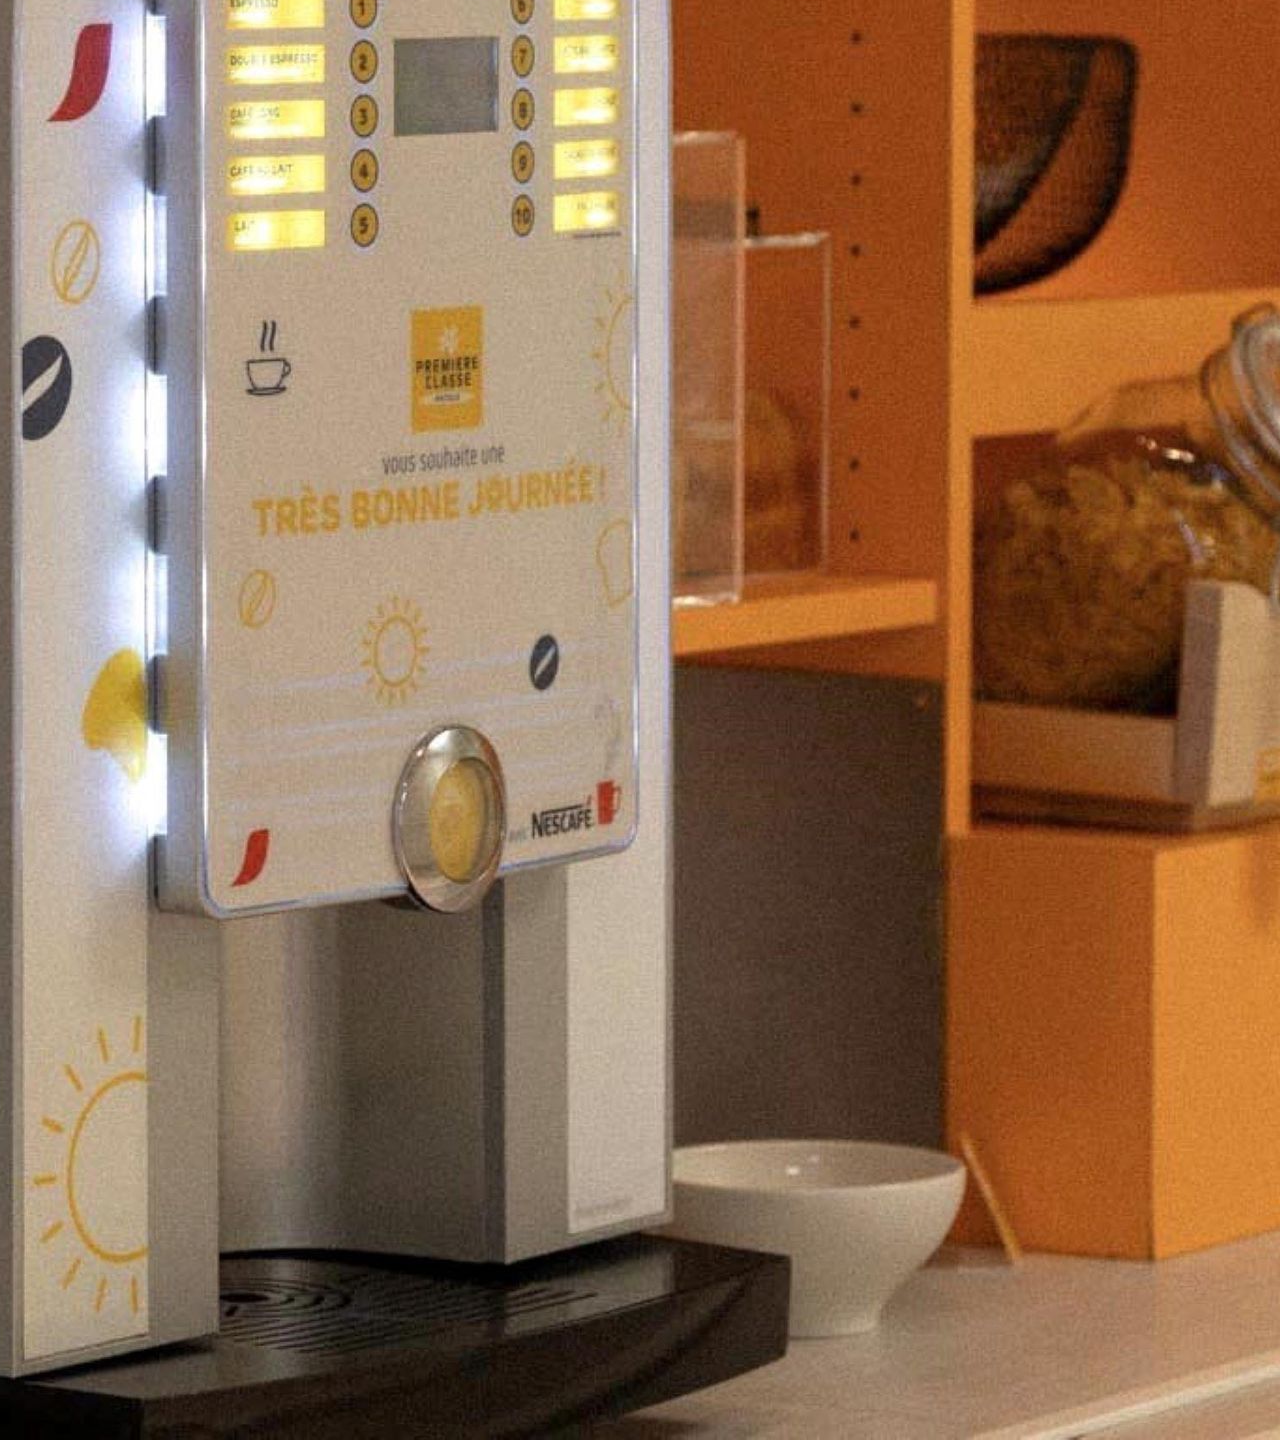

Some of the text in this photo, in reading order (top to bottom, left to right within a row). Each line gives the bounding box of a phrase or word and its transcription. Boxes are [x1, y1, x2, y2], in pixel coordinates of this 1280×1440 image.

[516, 207, 531, 225] 10
[425, 371, 472, 390] CLASSE
[382, 444, 506, 475] vous souhaite une
[252, 482, 342, 537] TRÈS
[350, 479, 461, 530] BONNE
[532, 794, 593, 840] NESCAFÉ
